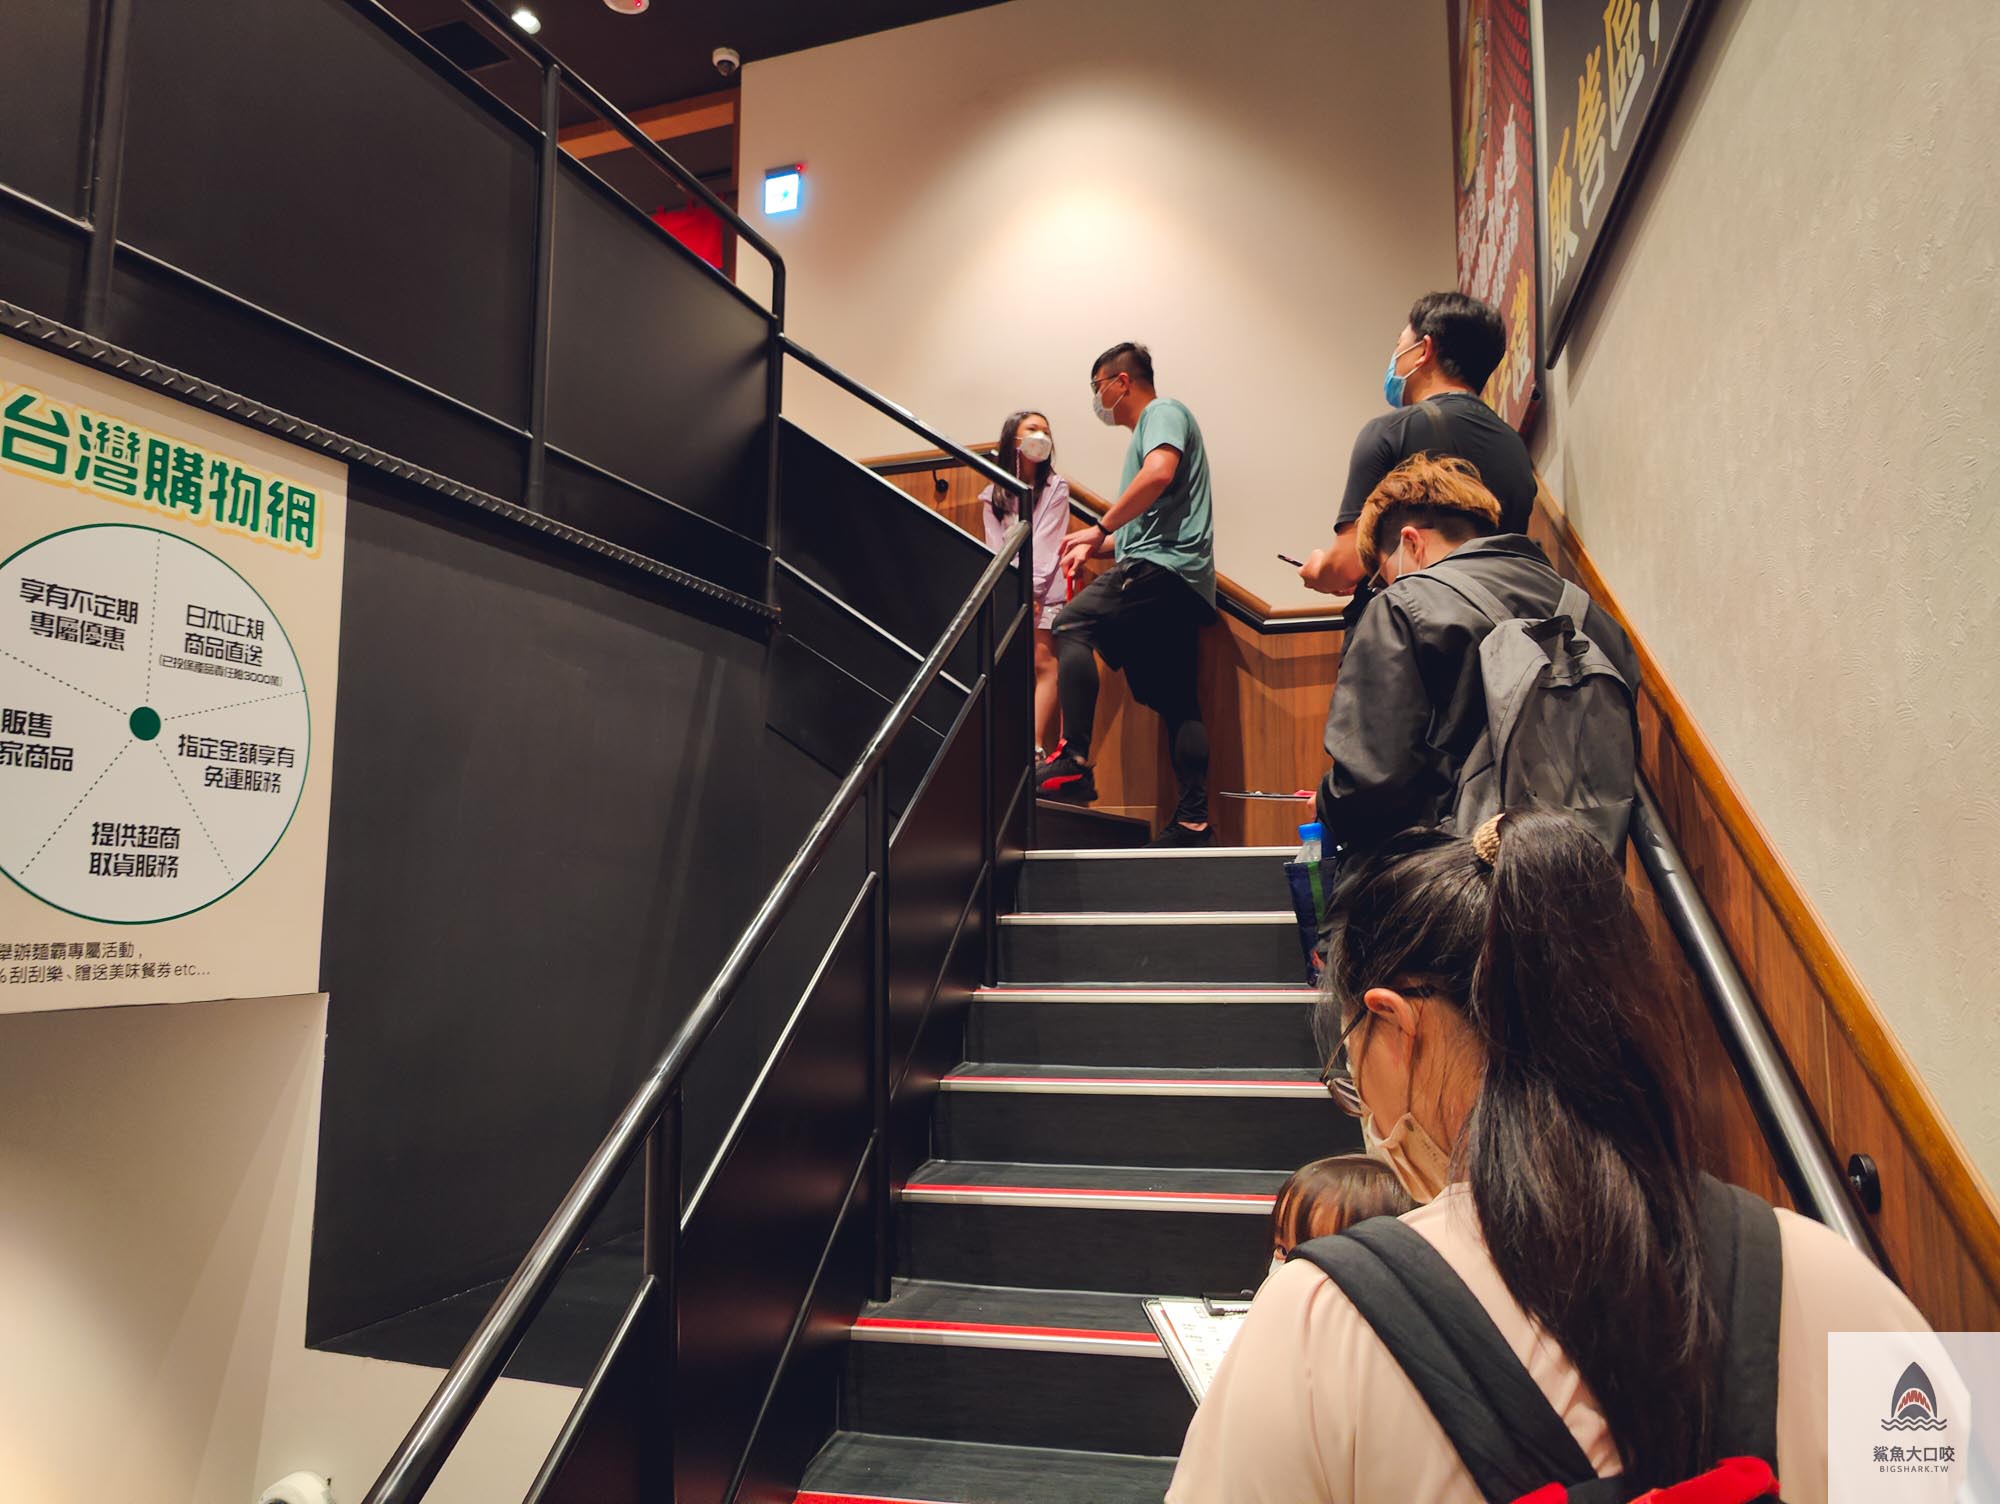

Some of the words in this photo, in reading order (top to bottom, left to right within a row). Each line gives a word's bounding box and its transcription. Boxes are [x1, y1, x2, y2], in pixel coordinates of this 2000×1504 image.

[1, 393, 317, 548] 台灣購物網
[20, 577, 139, 625] 享有不定期
[30, 610, 126, 651] 專屬優惠
[186, 604, 265, 641] 日本正規
[184, 632, 264, 667] 商品直送
[1, 708, 53, 738] 販售
[0, 740, 74, 772] 家商品
[178, 734, 296, 768] 指定金額享有
[204, 765, 282, 793] 免運服務
[91, 821, 181, 850] 提供超商
[89, 852, 179, 879] 取貨服務
